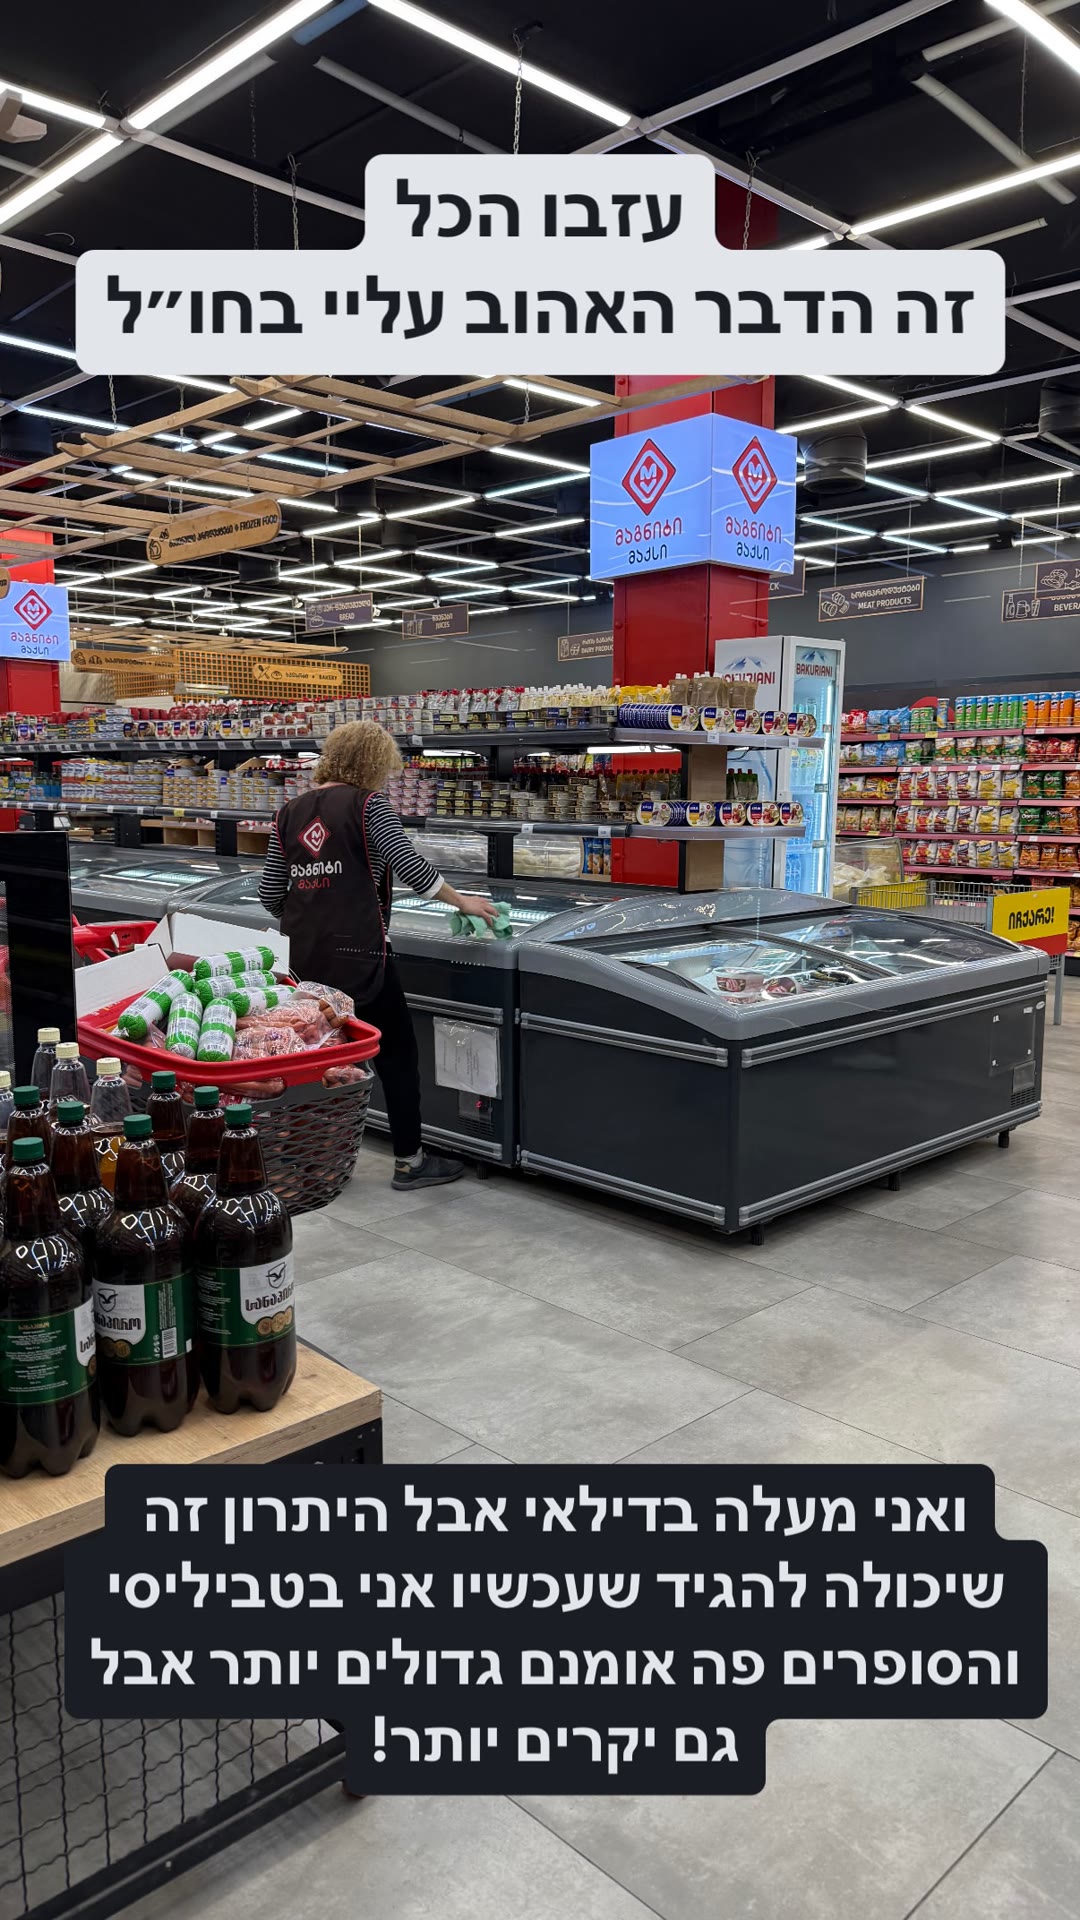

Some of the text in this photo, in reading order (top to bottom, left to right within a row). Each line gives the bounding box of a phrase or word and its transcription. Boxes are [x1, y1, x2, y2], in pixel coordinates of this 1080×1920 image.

[240, 514, 278, 531] FROZEN FOOD
[725, 515, 782, 545] მაგნიტი
[615, 516, 683, 546] მაგნიტი
[628, 543, 668, 565] მაქსი
[736, 541, 770, 561] მაქსი
[857, 596, 912, 610] MEAT PRODUCTS
[339, 612, 356, 622] BREAD
[435, 621, 450, 630] JUICES
[10, 631, 59, 645] მაგნიტი
[20, 645, 50, 656] მაქსი
[319, 674, 338, 682] BAKERY
[795, 662, 833, 678] BAKURIANI
[290, 860, 343, 878] მაგნიტი
[297, 877, 331, 890] მაქსი
[1008, 906, 1055, 930] იჩქარე!
